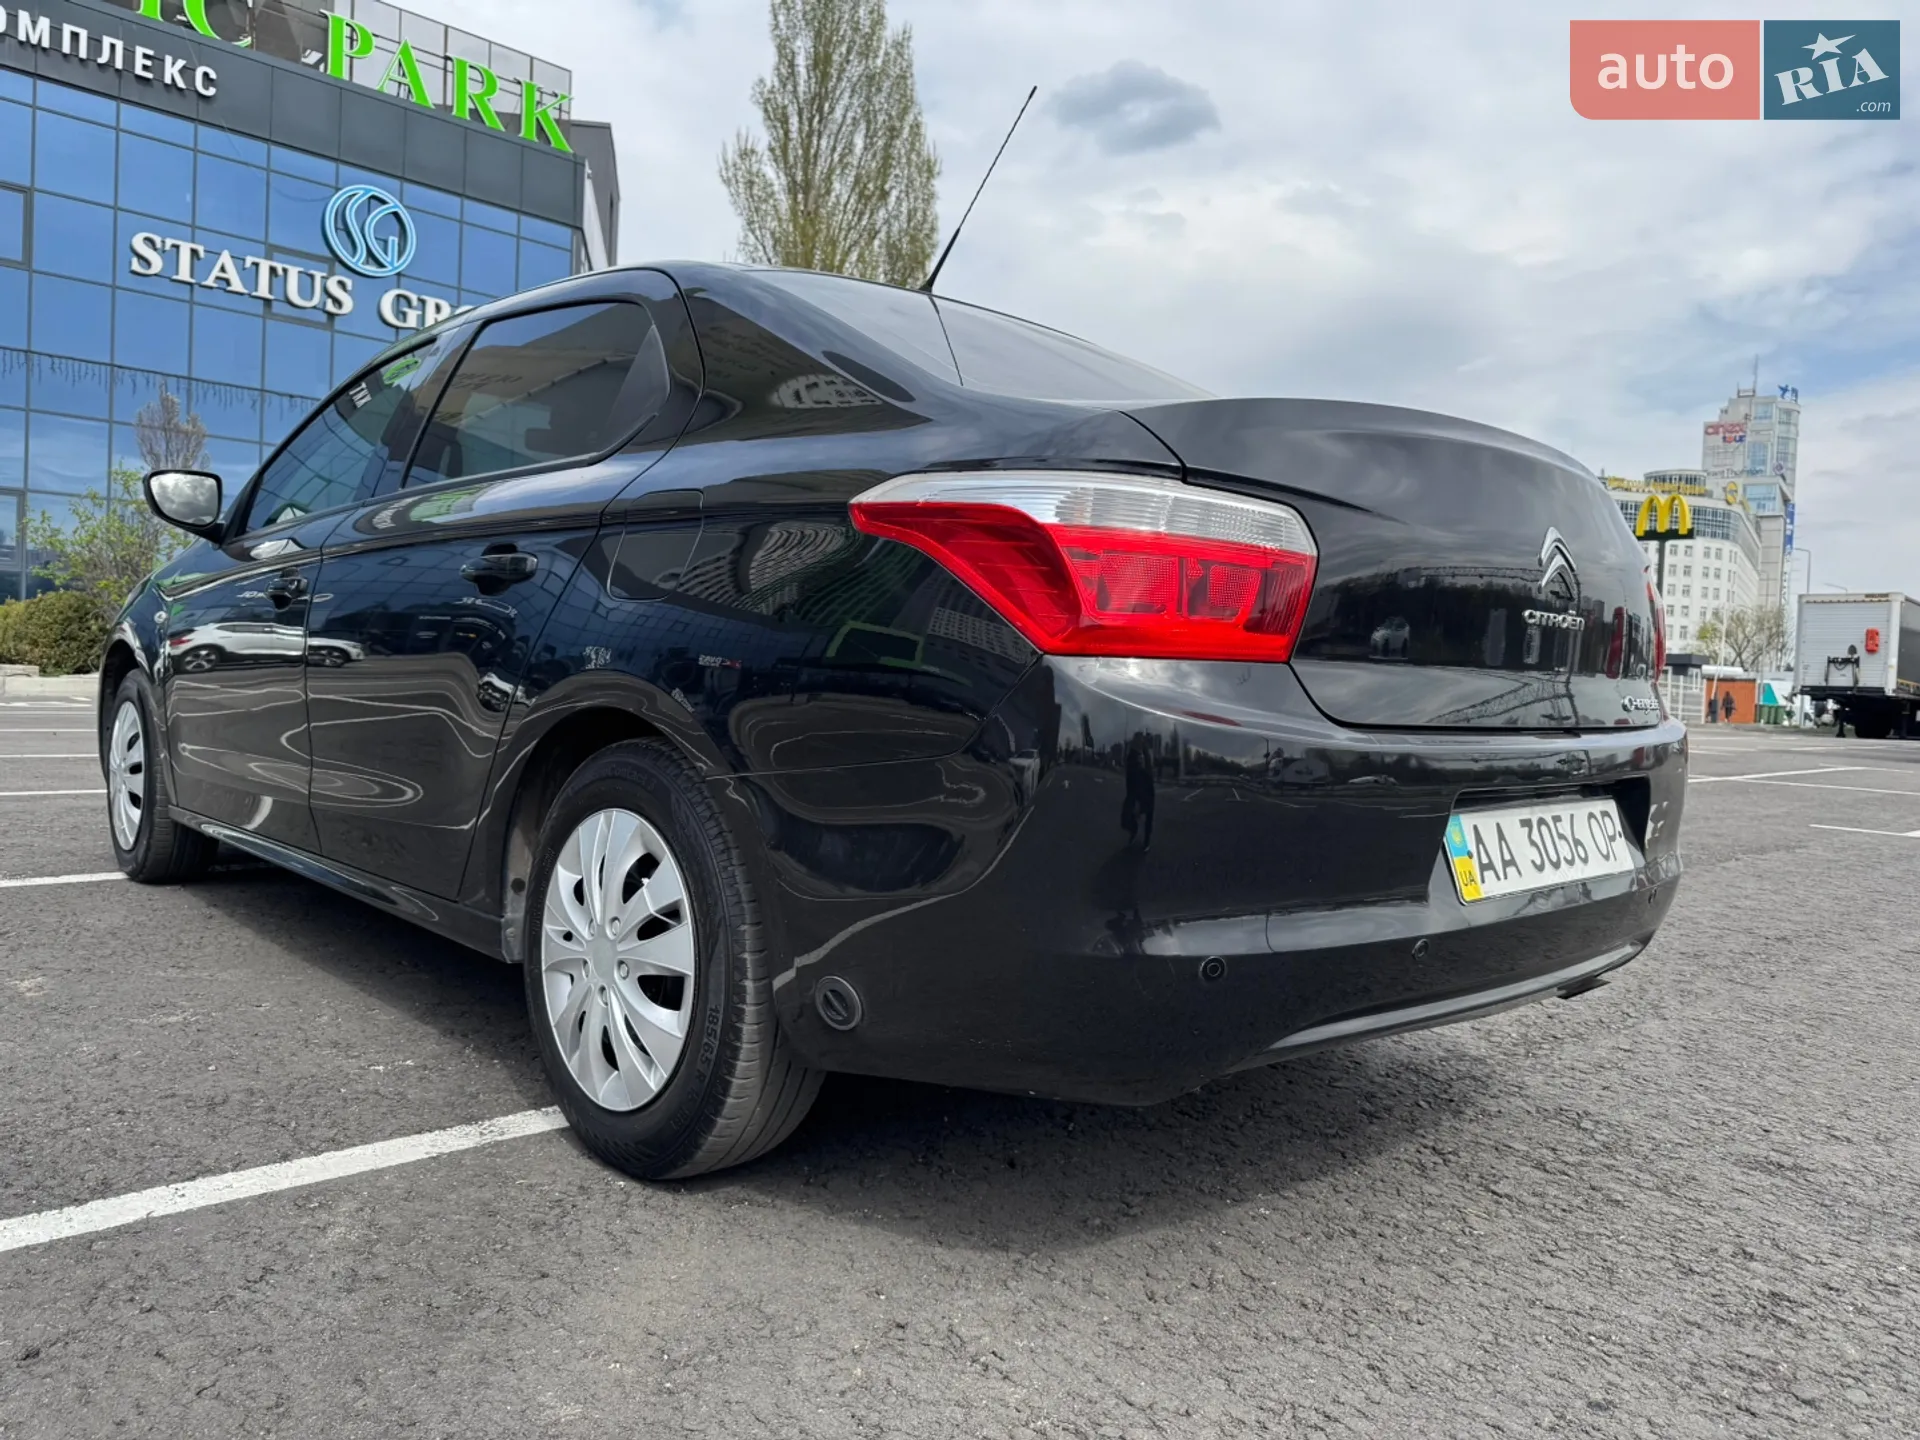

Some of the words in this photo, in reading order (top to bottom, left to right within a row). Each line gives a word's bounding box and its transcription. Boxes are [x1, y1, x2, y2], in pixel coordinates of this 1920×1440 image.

[0, 5, 217, 97] МПЛЕКС
[319, 9, 574, 153] PARK
[130, 232, 354, 315] STATUS
[379, 288, 473, 329] GR
[1459, 870, 1478, 887] UA
[1472, 822, 1523, 884] AA
[1519, 813, 1589, 873] 3056
[1586, 810, 1618, 862] OP
